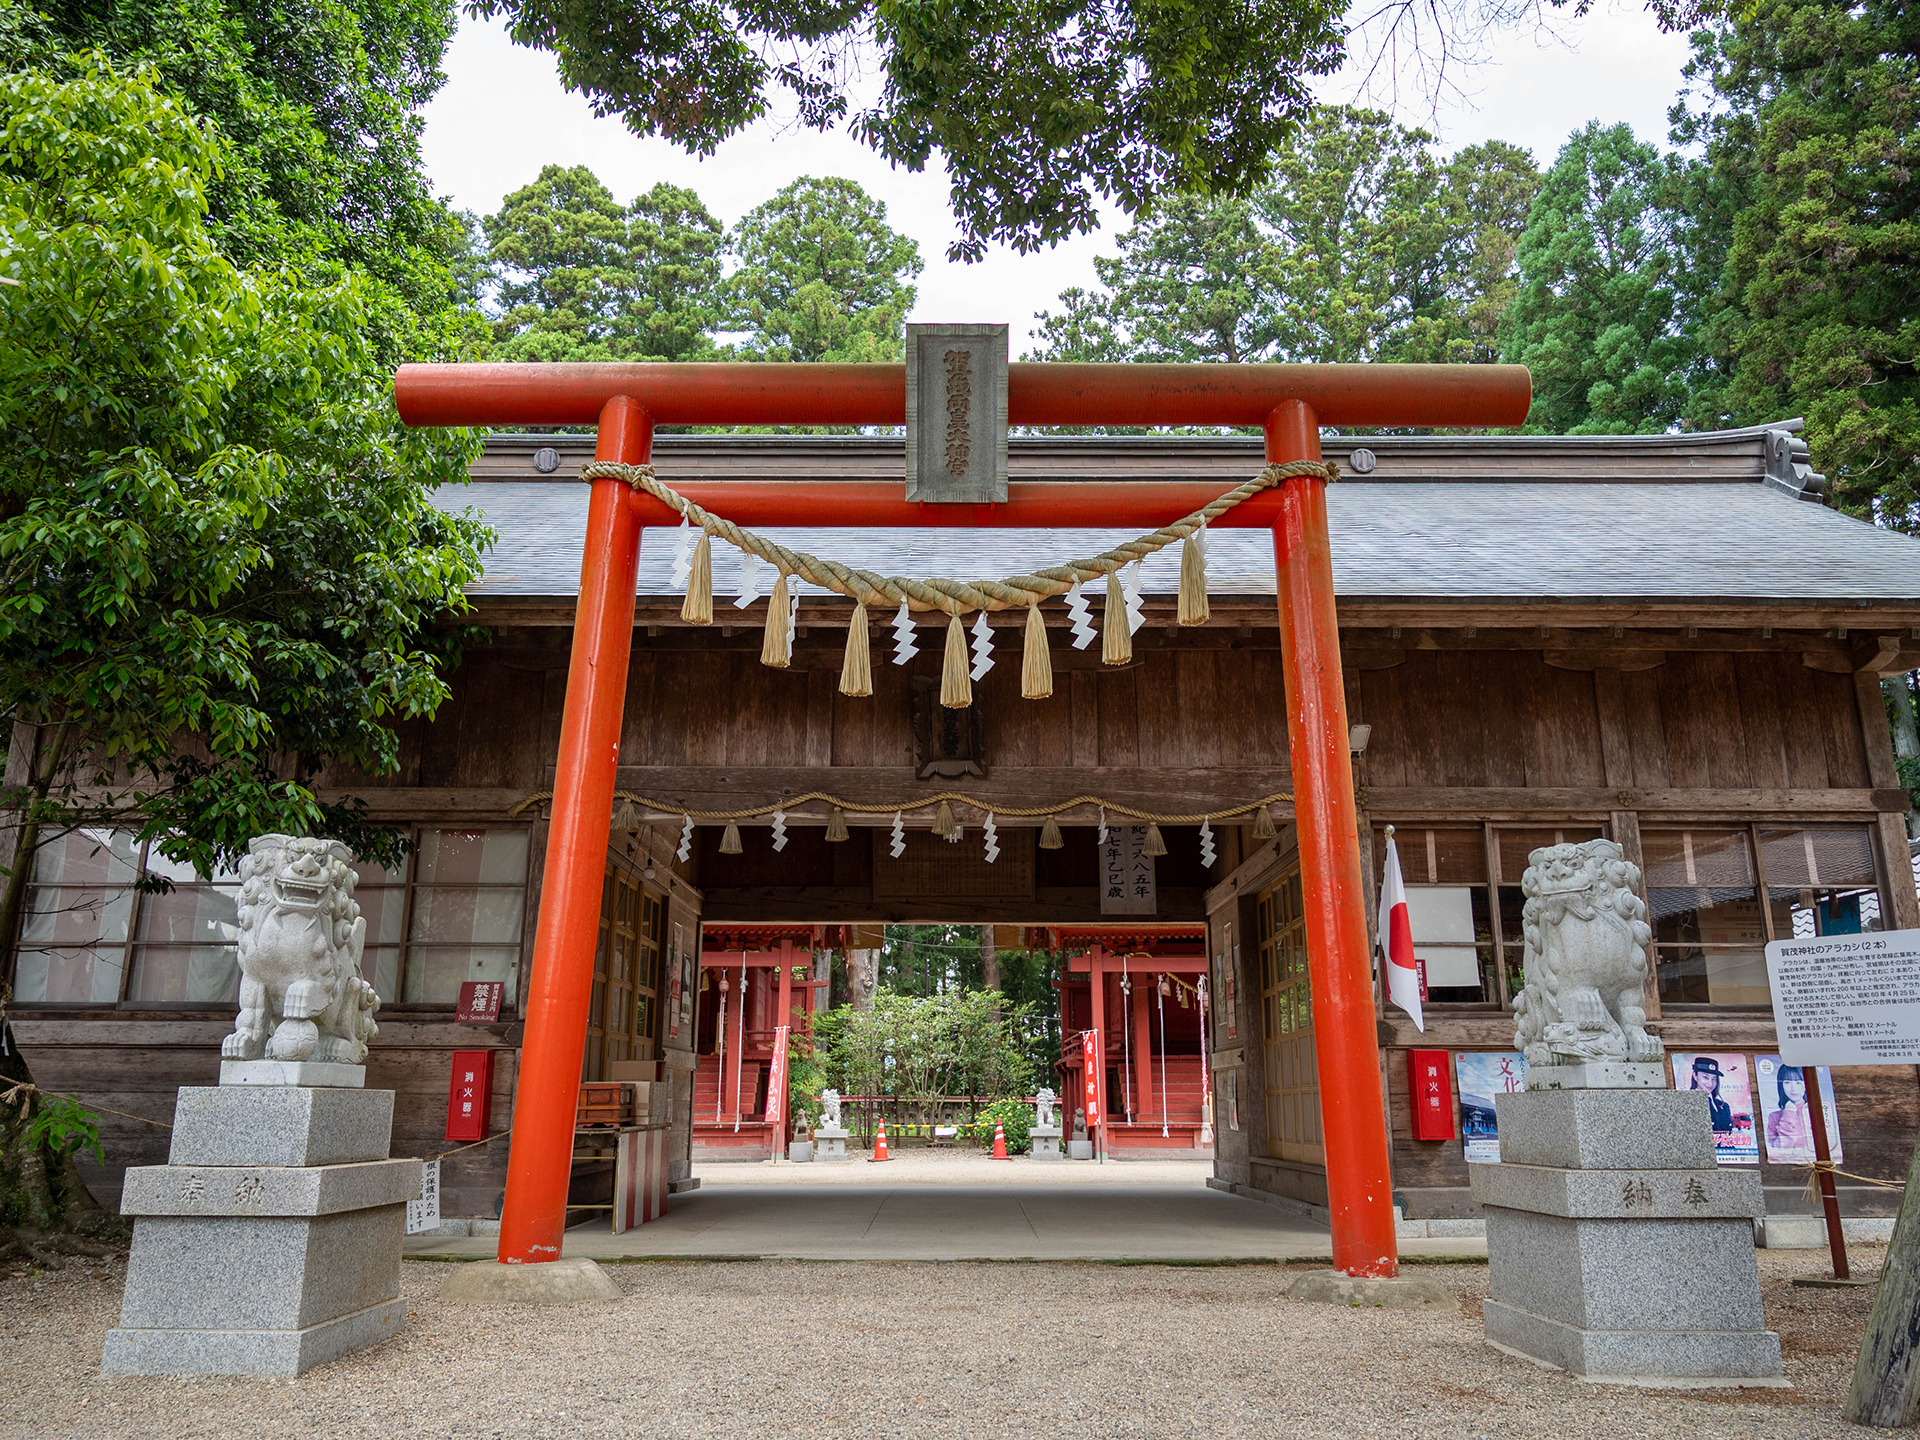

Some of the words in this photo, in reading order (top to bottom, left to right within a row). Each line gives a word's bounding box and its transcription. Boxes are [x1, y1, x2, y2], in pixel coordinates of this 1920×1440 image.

[471, 983, 490, 1012] 禁煙
[458, 1013, 468, 1021] No
[469, 1013, 495, 1021] Smoking
[462, 1071, 474, 1113] 消火器
[1427, 1066, 1440, 1107] 消火器
